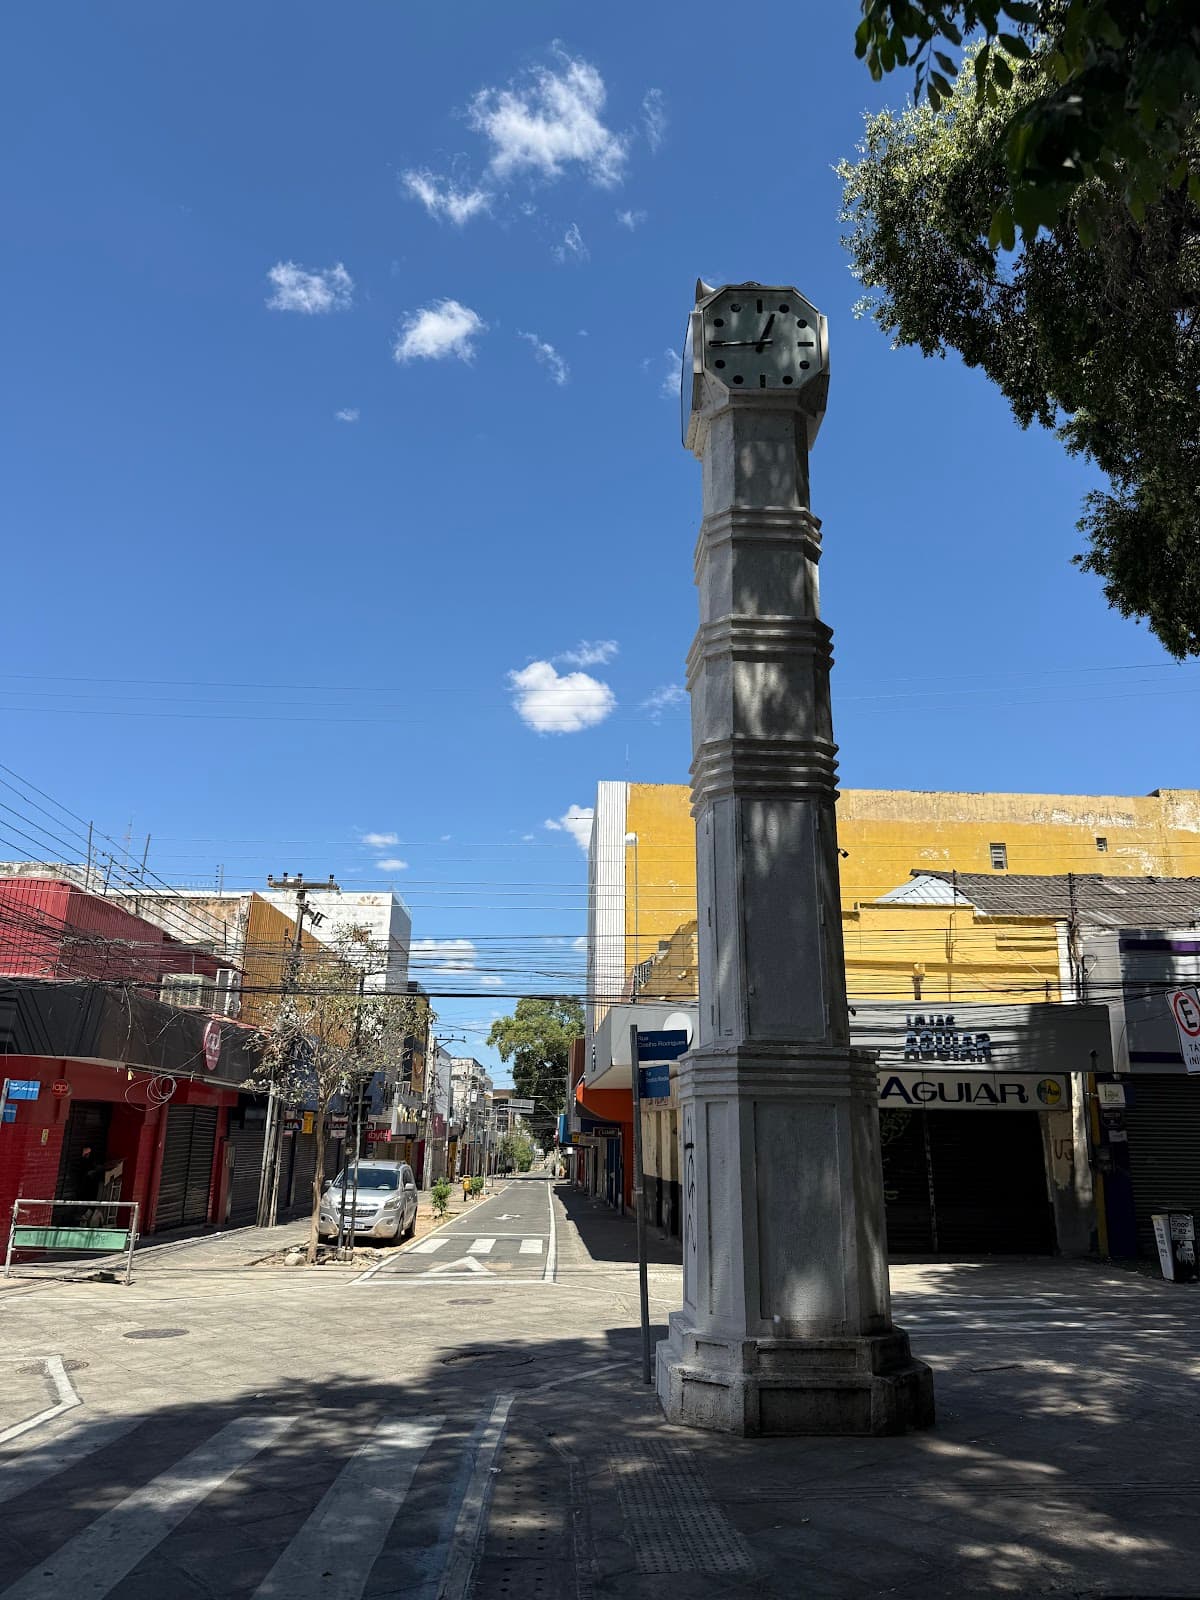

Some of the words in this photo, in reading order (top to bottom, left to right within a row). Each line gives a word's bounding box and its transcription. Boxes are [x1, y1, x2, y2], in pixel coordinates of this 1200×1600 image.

[1179, 999, 1198, 1029] E
[904, 1029, 992, 1062] AGUIAR
[880, 1076, 1029, 1105] AGUIAR
